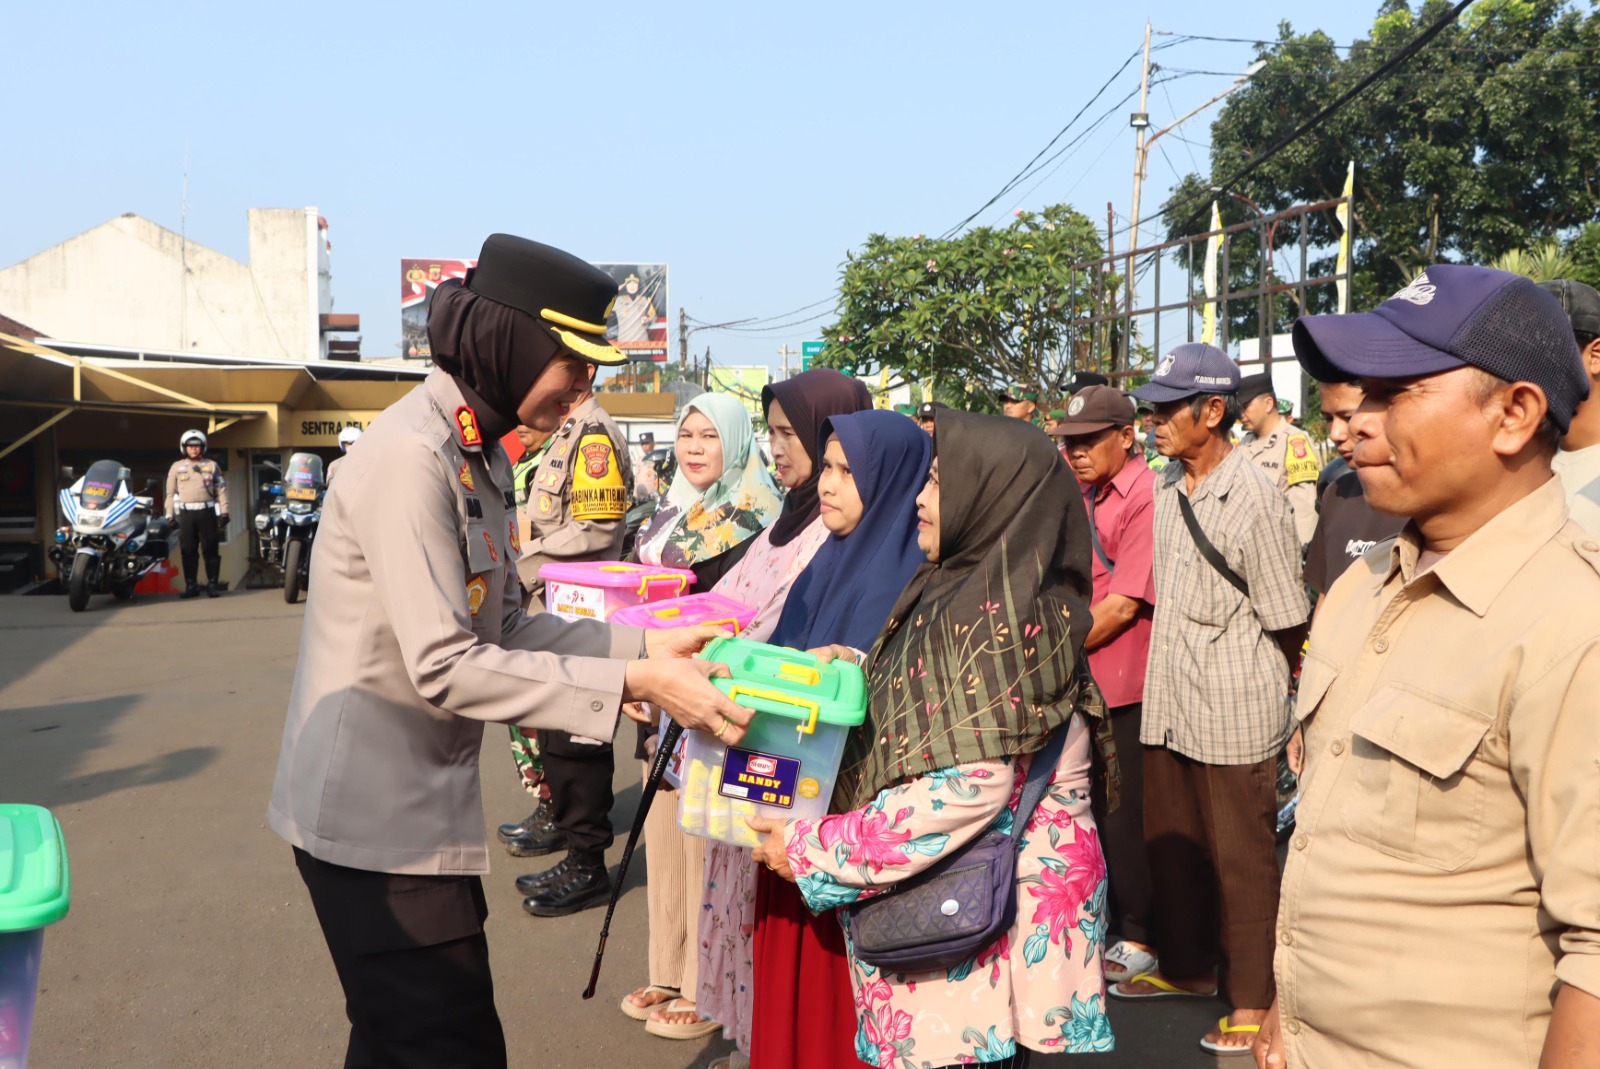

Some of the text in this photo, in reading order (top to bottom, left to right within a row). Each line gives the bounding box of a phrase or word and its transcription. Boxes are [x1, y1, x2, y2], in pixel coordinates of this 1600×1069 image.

[302, 421, 342, 435] SENTRA
[738, 773, 781, 788] HANDY
[762, 792, 791, 805] CB 15
